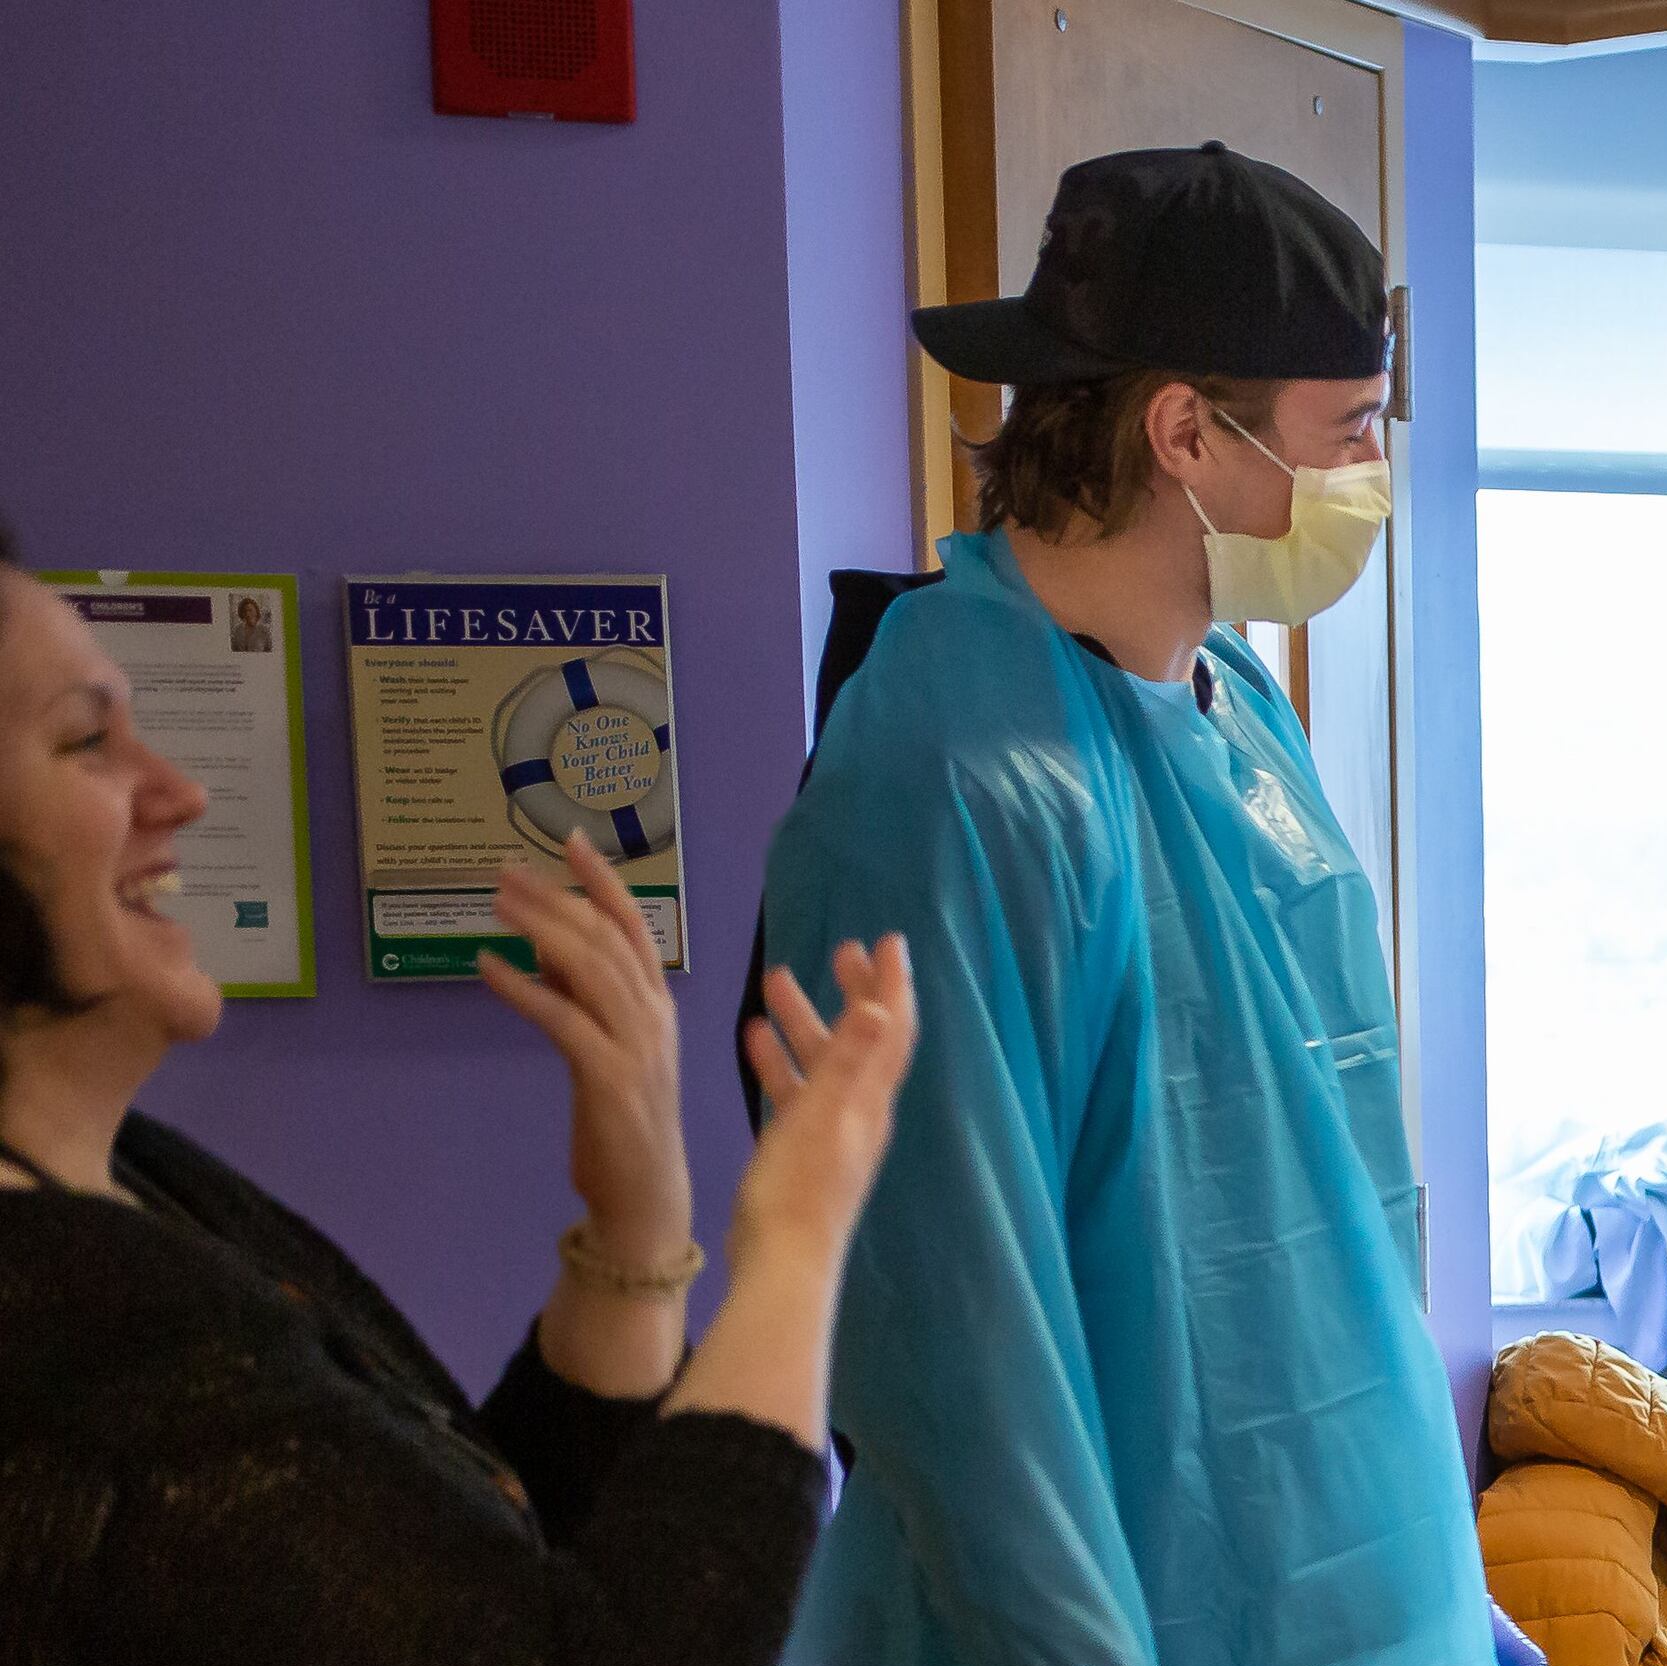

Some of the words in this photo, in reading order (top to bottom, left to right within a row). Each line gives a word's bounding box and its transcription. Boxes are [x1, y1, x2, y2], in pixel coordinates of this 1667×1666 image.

[364, 589, 384, 606] Be
[386, 593, 397, 606] a
[365, 609, 656, 641] LIFESAVER
[365, 657, 415, 670] Everyone
[379, 675, 407, 685] Wash
[566, 719, 590, 736] No
[596, 714, 630, 730] One
[576, 732, 628, 750] Knows
[562, 753, 600, 770] Your
[605, 741, 650, 763] Child
[584, 763, 634, 781] Better
[573, 781, 616, 800] Than
[623, 777, 652, 791] You
[385, 795, 410, 806] Keep
[420, 856, 447, 866] child's
